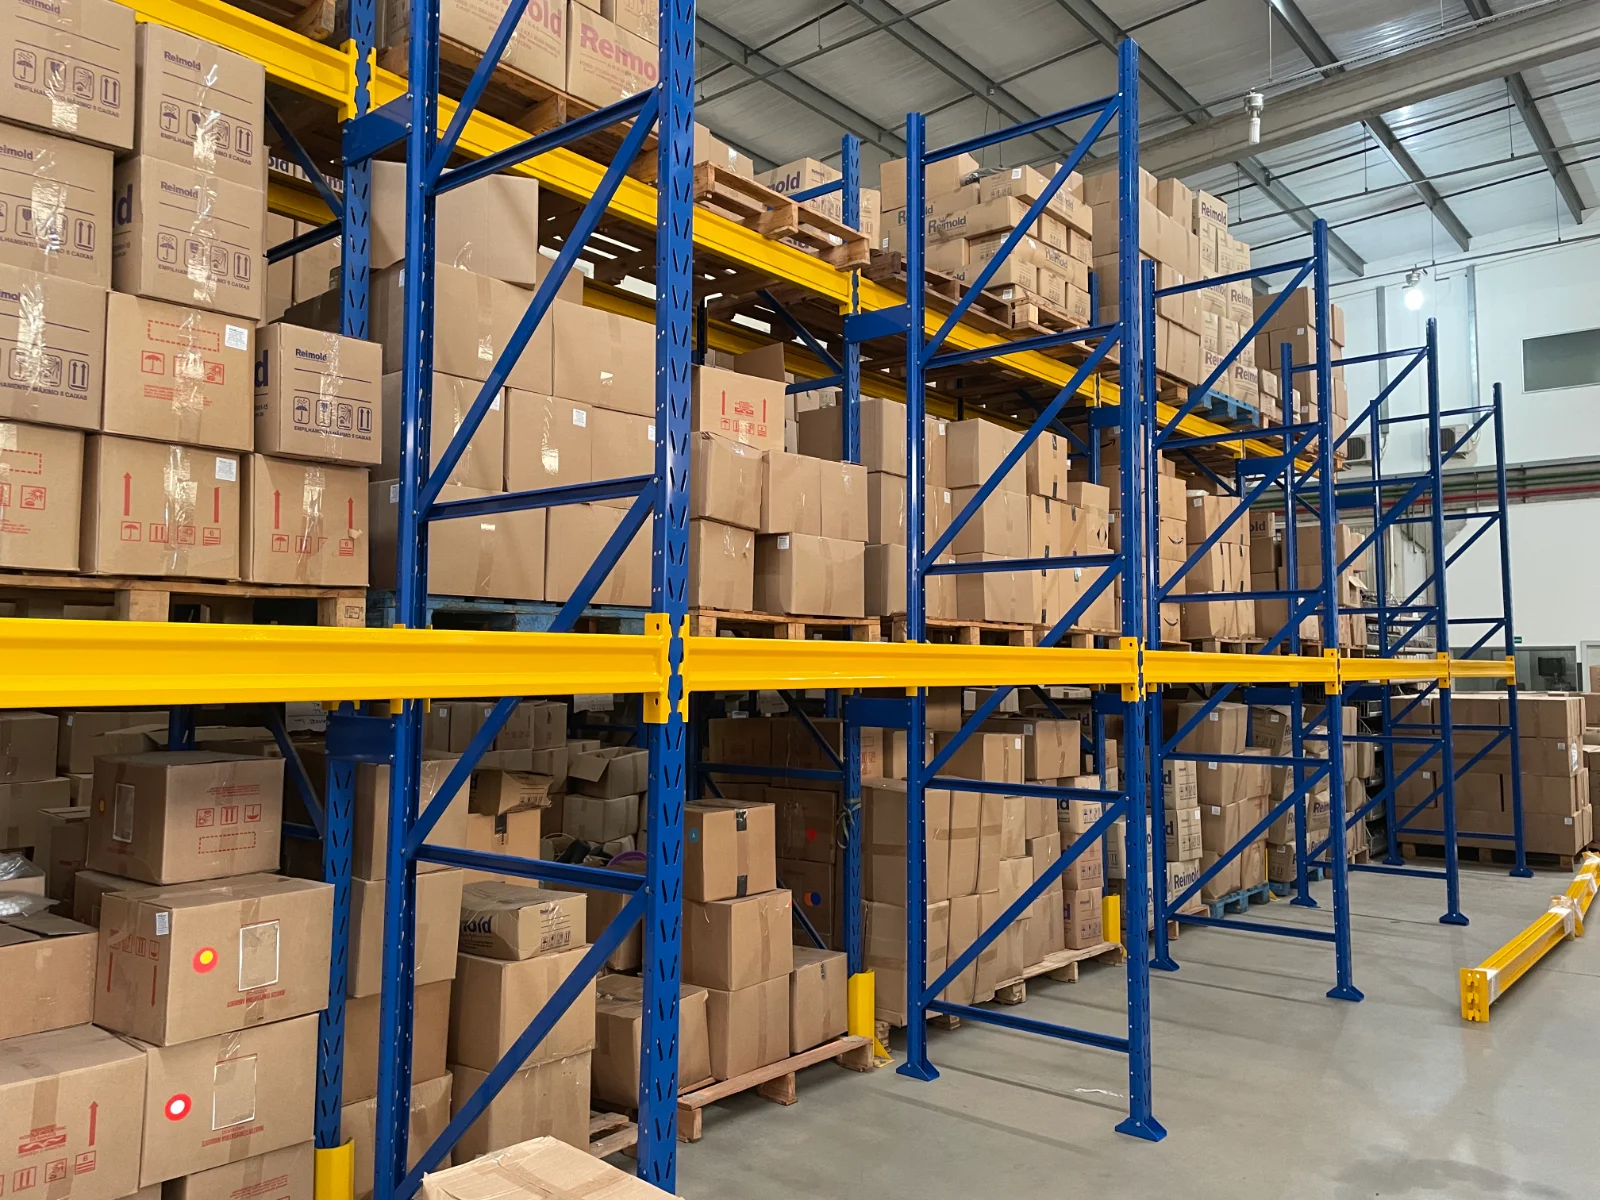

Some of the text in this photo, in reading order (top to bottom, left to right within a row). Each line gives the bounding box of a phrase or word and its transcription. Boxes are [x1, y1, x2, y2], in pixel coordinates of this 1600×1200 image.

[18, 0, 60, 14] eimold
[580, 22, 657, 81] Reimo
[163, 51, 201, 71] Reimold
[0, 145, 33, 160] eimold
[160, 180, 199, 199] Reimold
[1201, 202, 1227, 226] Reimold
[295, 348, 328, 361] Reimold
[65, 391, 88, 401] CAIXAS
[1250, 521, 1266, 531] old
